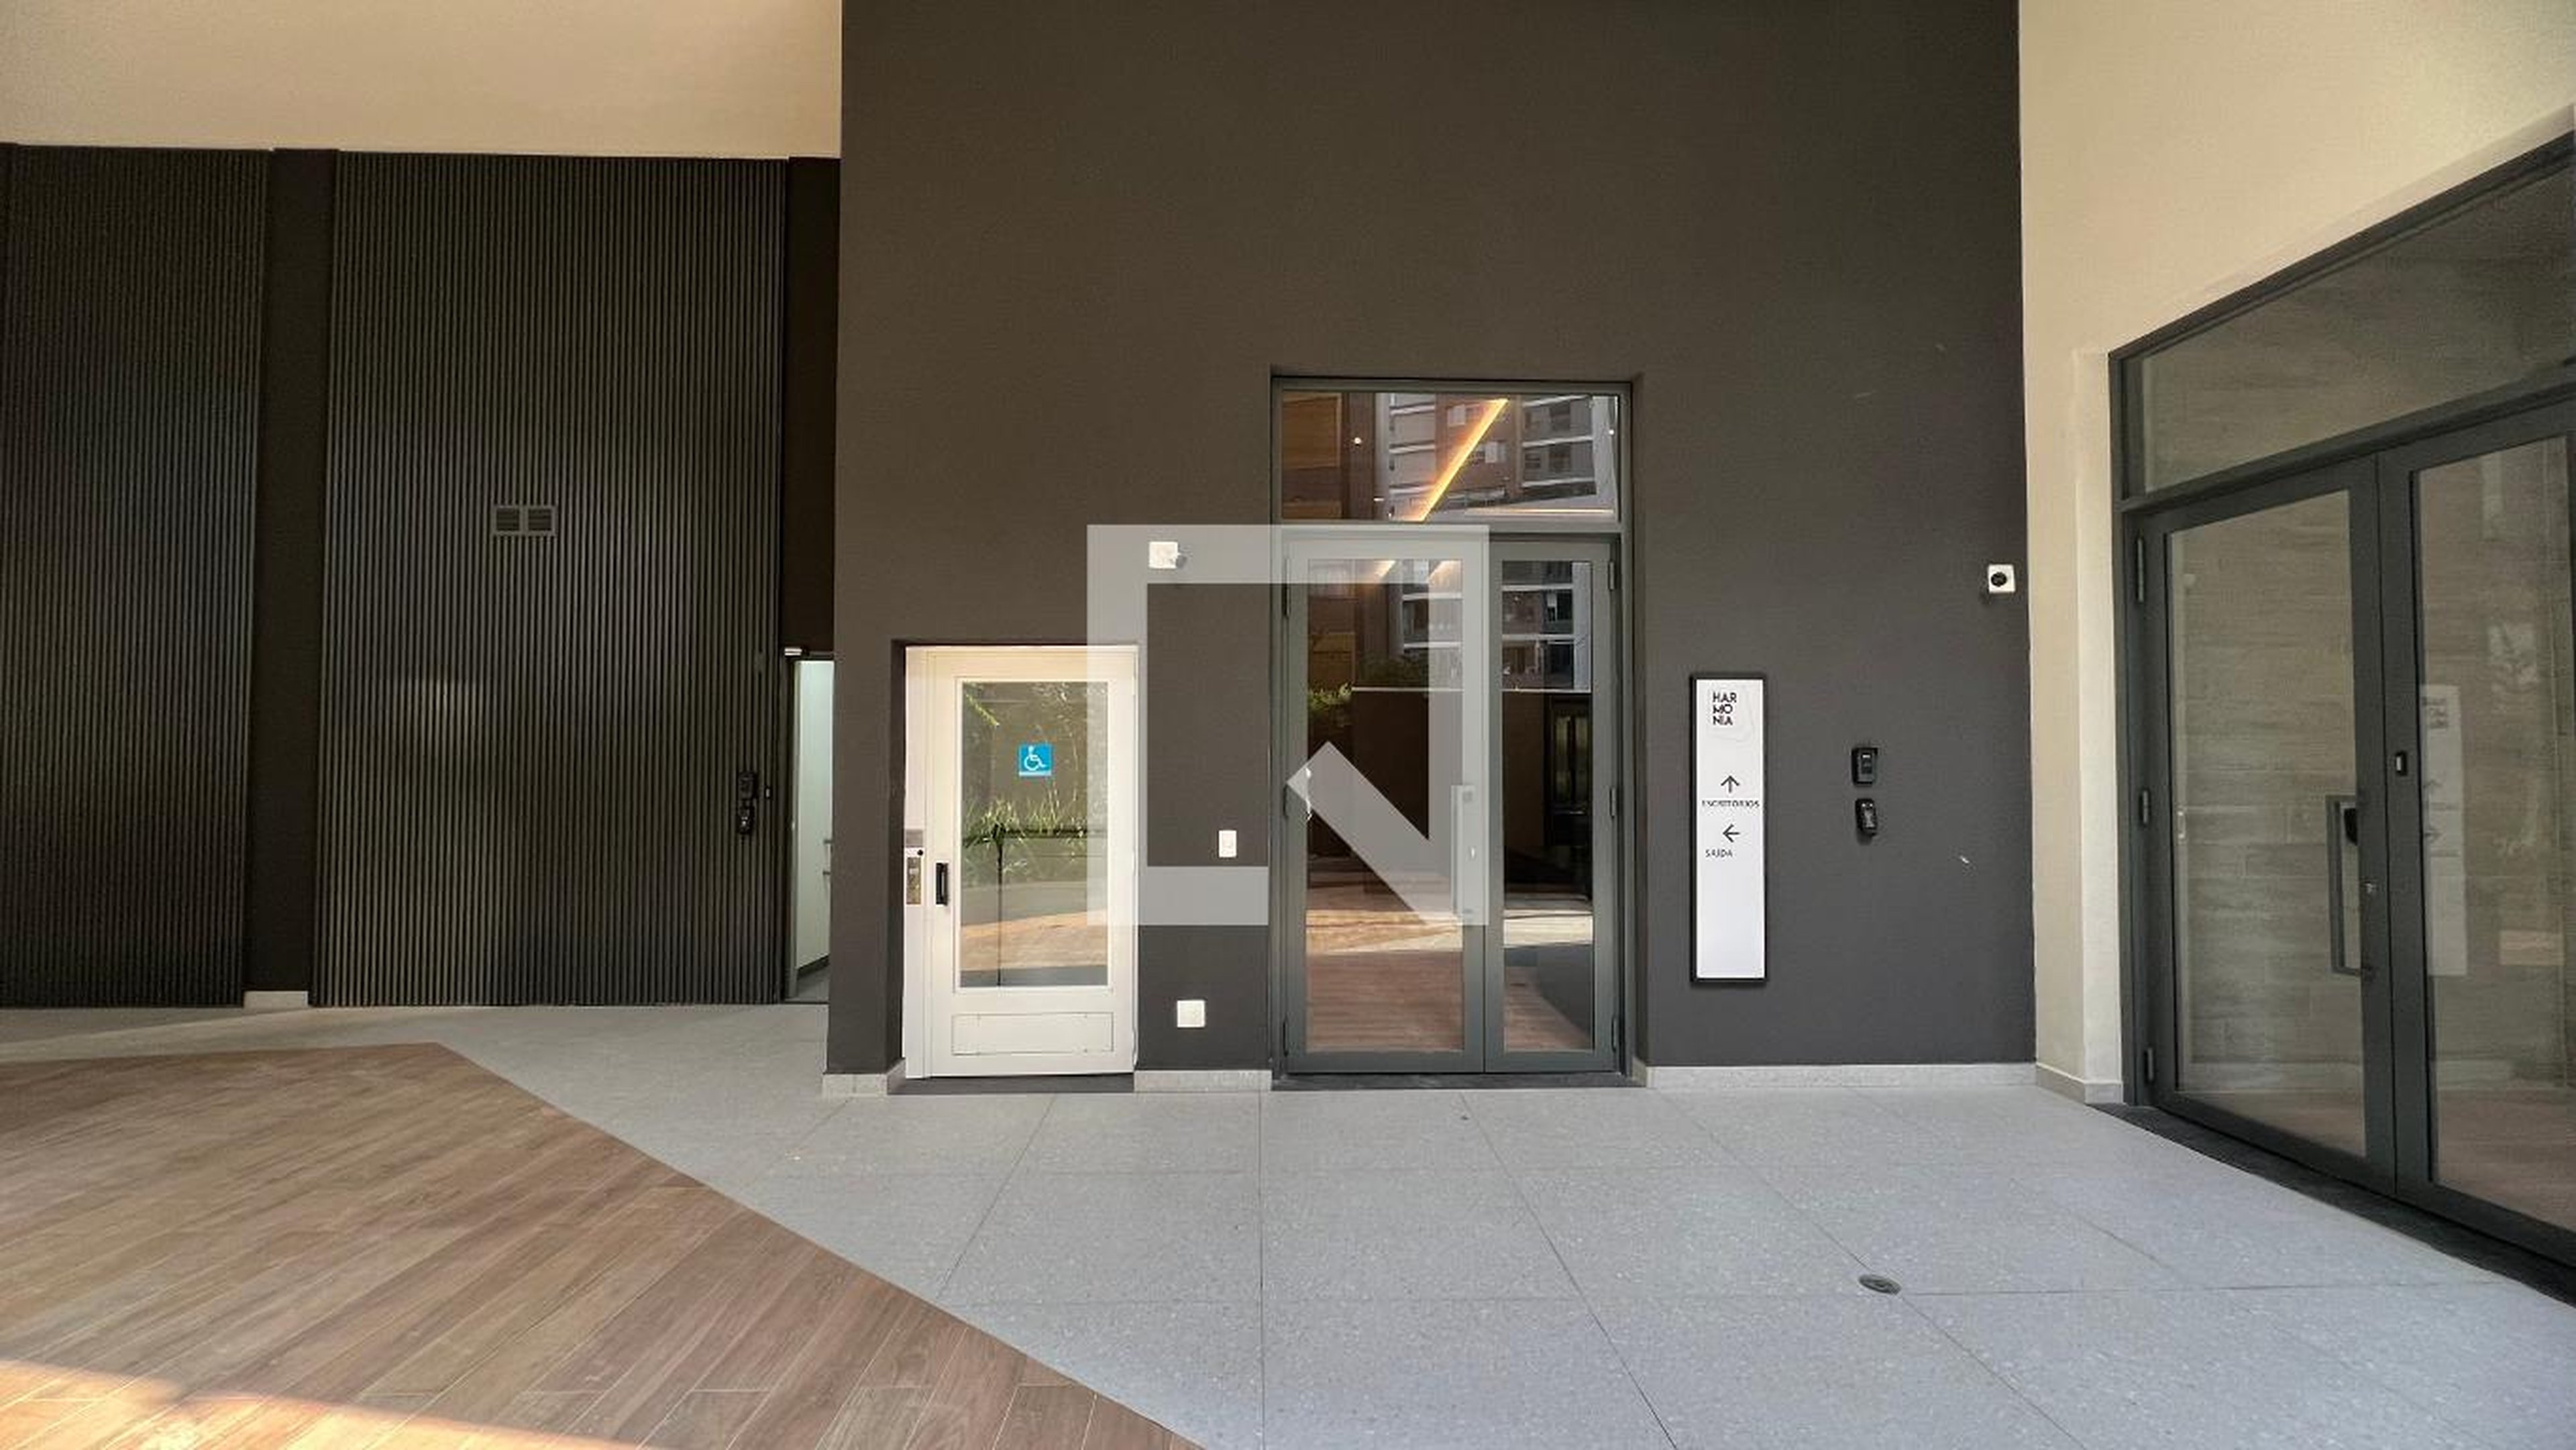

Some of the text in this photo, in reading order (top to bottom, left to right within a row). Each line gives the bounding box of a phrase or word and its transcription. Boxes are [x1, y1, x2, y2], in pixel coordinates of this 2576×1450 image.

[1713, 692, 1737, 703] HAR
[1713, 704, 1733, 714] MO
[1713, 715, 1733, 725] NIA
